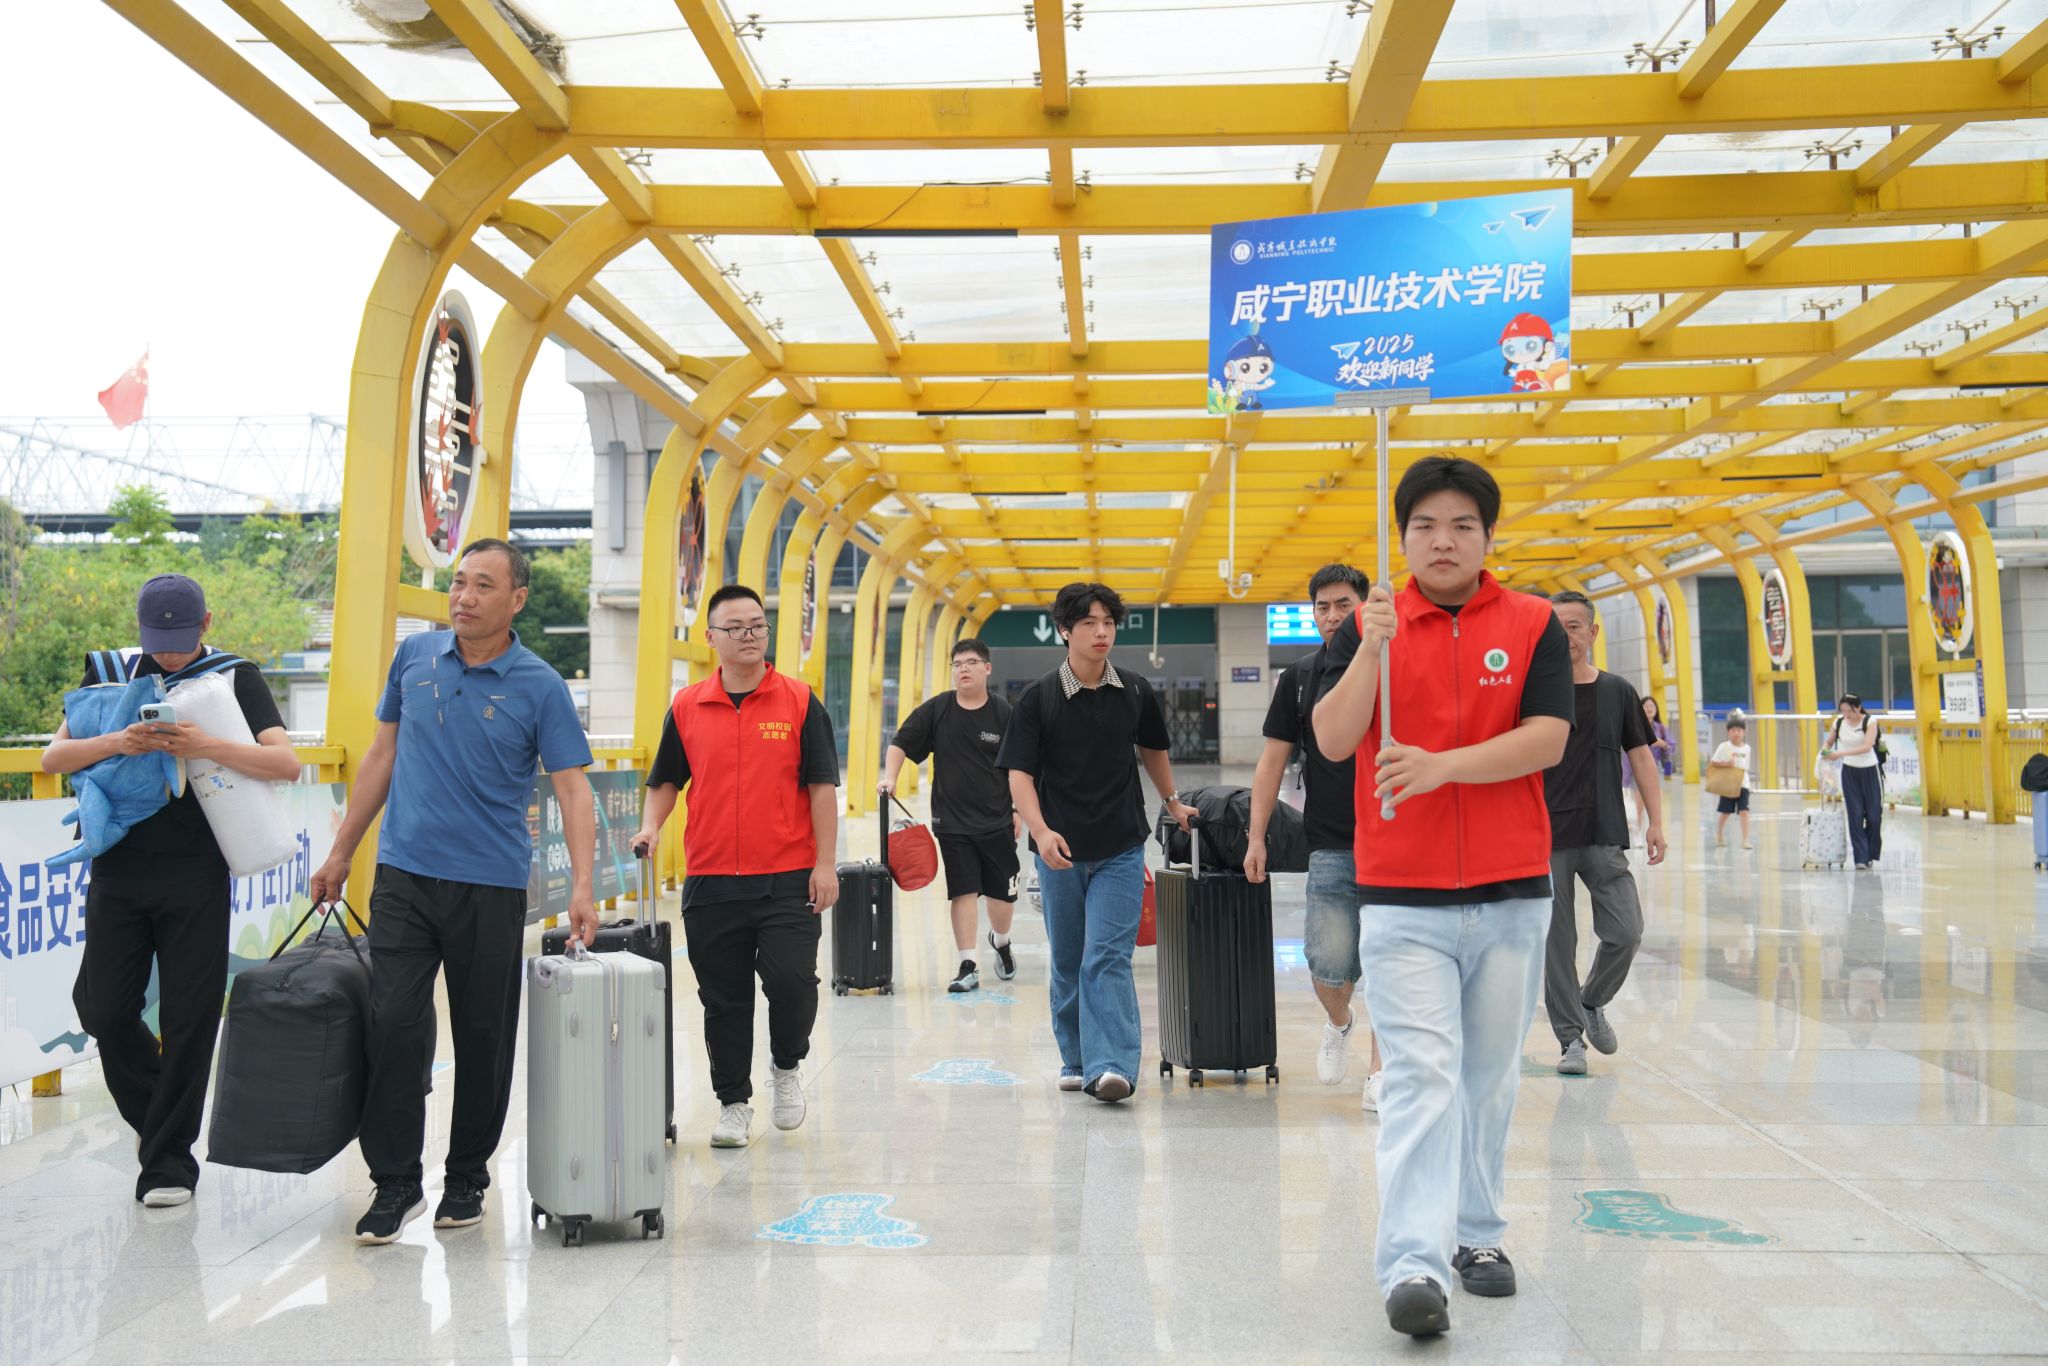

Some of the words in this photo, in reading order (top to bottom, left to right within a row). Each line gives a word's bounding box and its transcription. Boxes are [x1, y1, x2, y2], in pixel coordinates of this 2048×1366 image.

[1292, 246, 1336, 256] POLYTECHNIC
[1230, 260, 1547, 326] 咸宁职业技术学院
[1363, 333, 1415, 356] 2025
[1335, 352, 1435, 387] 欢迎新同学
[758, 722, 791, 731] 文明校园
[763, 732, 787, 740] 志愿者
